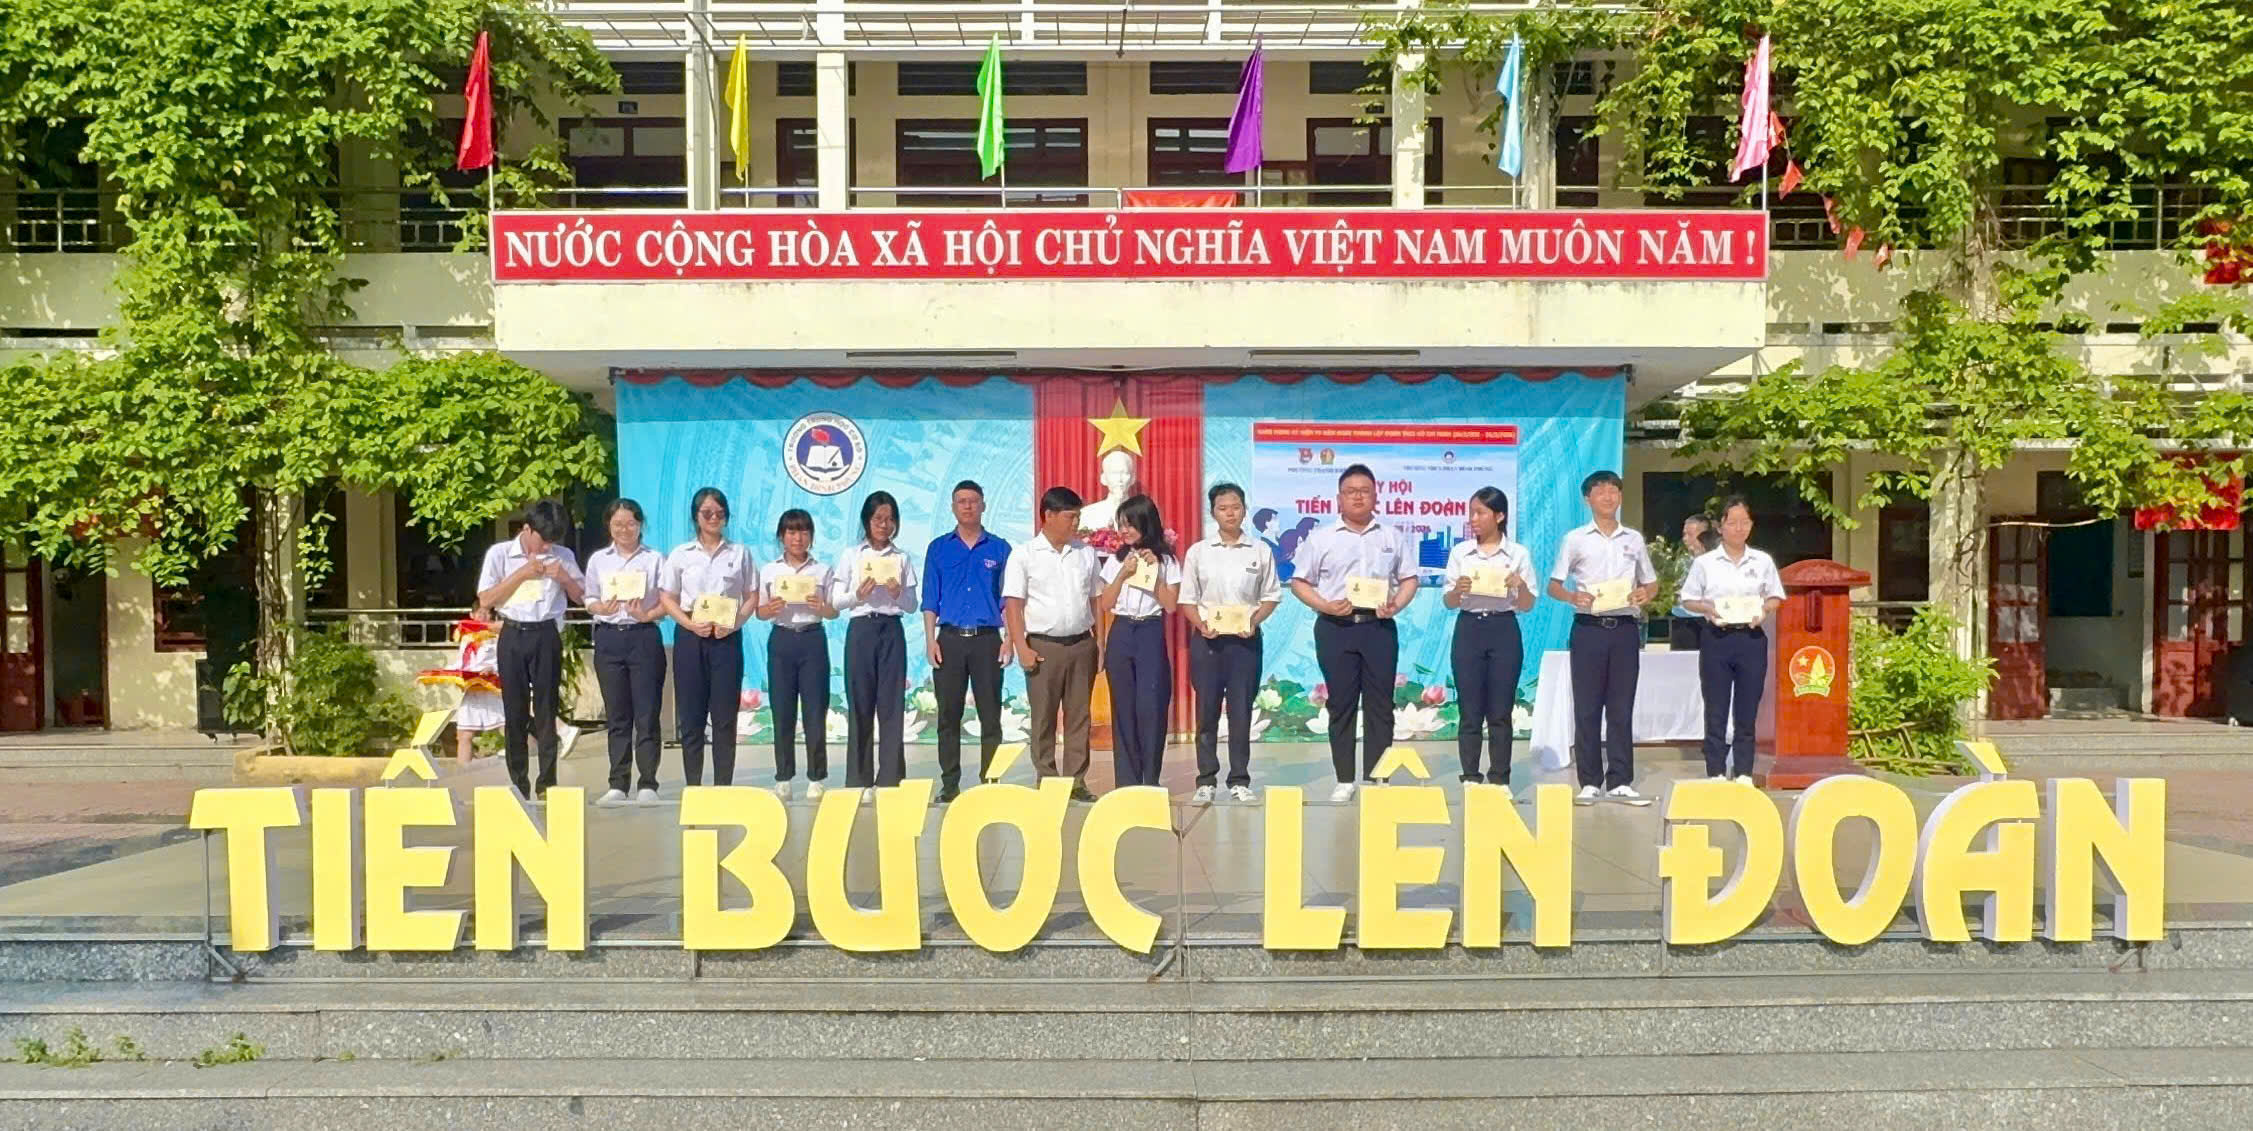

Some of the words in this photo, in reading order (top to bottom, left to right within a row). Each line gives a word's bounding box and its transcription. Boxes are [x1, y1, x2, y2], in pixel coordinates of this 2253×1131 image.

[503, 216, 622, 268] NƯỚC
[635, 219, 755, 276] CỘNG
[767, 219, 860, 267] HÒA
[871, 220, 929, 266] XÃ
[943, 219, 1022, 275] HỘI
[1035, 214, 1124, 266] CHỦ
[1134, 219, 1271, 265] NGHĨA
[1282, 218, 1382, 273] VIỆT
[1393, 228, 1487, 265] NAM
[1498, 218, 1625, 265] MUÔN
[1637, 220, 1734, 265] NĂM
[1296, 494, 1331, 514] TIẾN
[1386, 497, 1414, 515] LÊN
[1419, 497, 1466, 516] ĐOÀN
[1389, 479, 1412, 495] HỘI
[190, 709, 590, 951] TIẾN
[679, 743, 1172, 954] BƯỚC
[1263, 746, 1573, 950] LÊN
[1656, 740, 2166, 945] ĐOÀN
